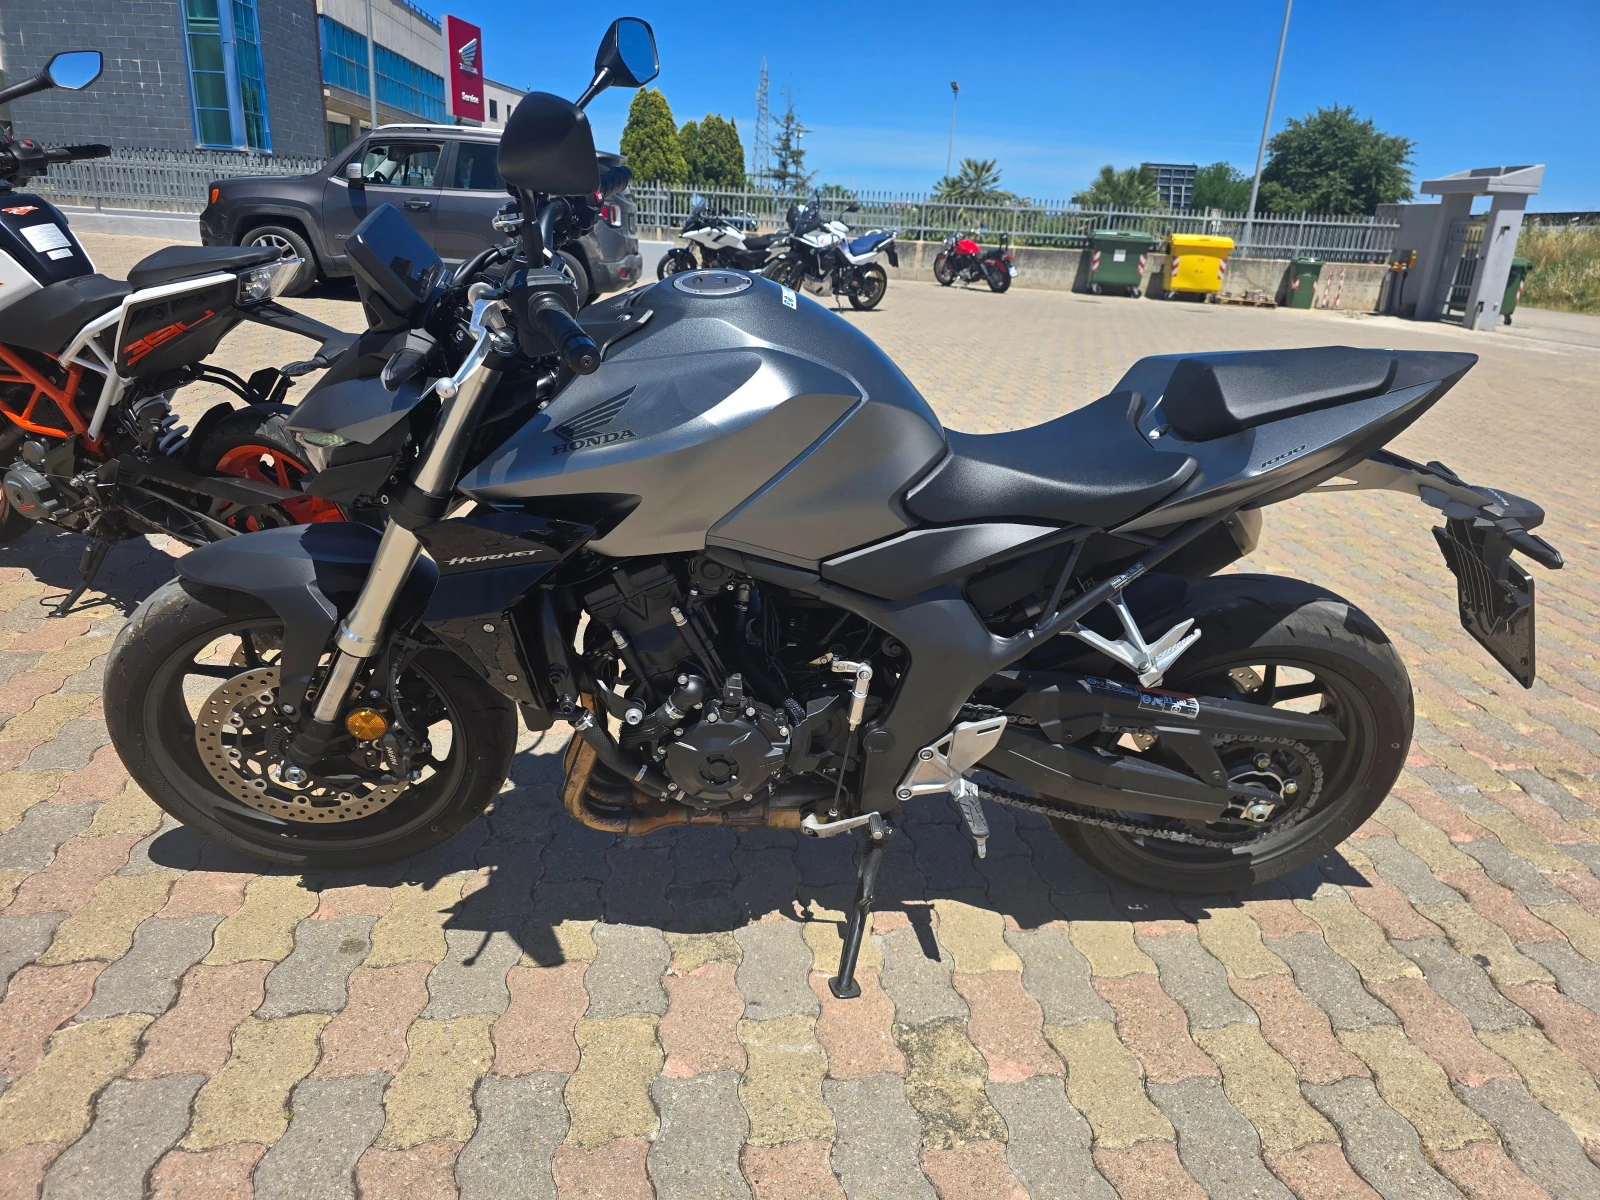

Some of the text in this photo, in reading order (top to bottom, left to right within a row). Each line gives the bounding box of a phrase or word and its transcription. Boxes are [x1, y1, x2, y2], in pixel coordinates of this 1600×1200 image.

[461, 91, 480, 104] Service
[551, 429, 637, 456] HONDA
[1261, 444, 1306, 469] 1000
[444, 549, 543, 566] HORNET
